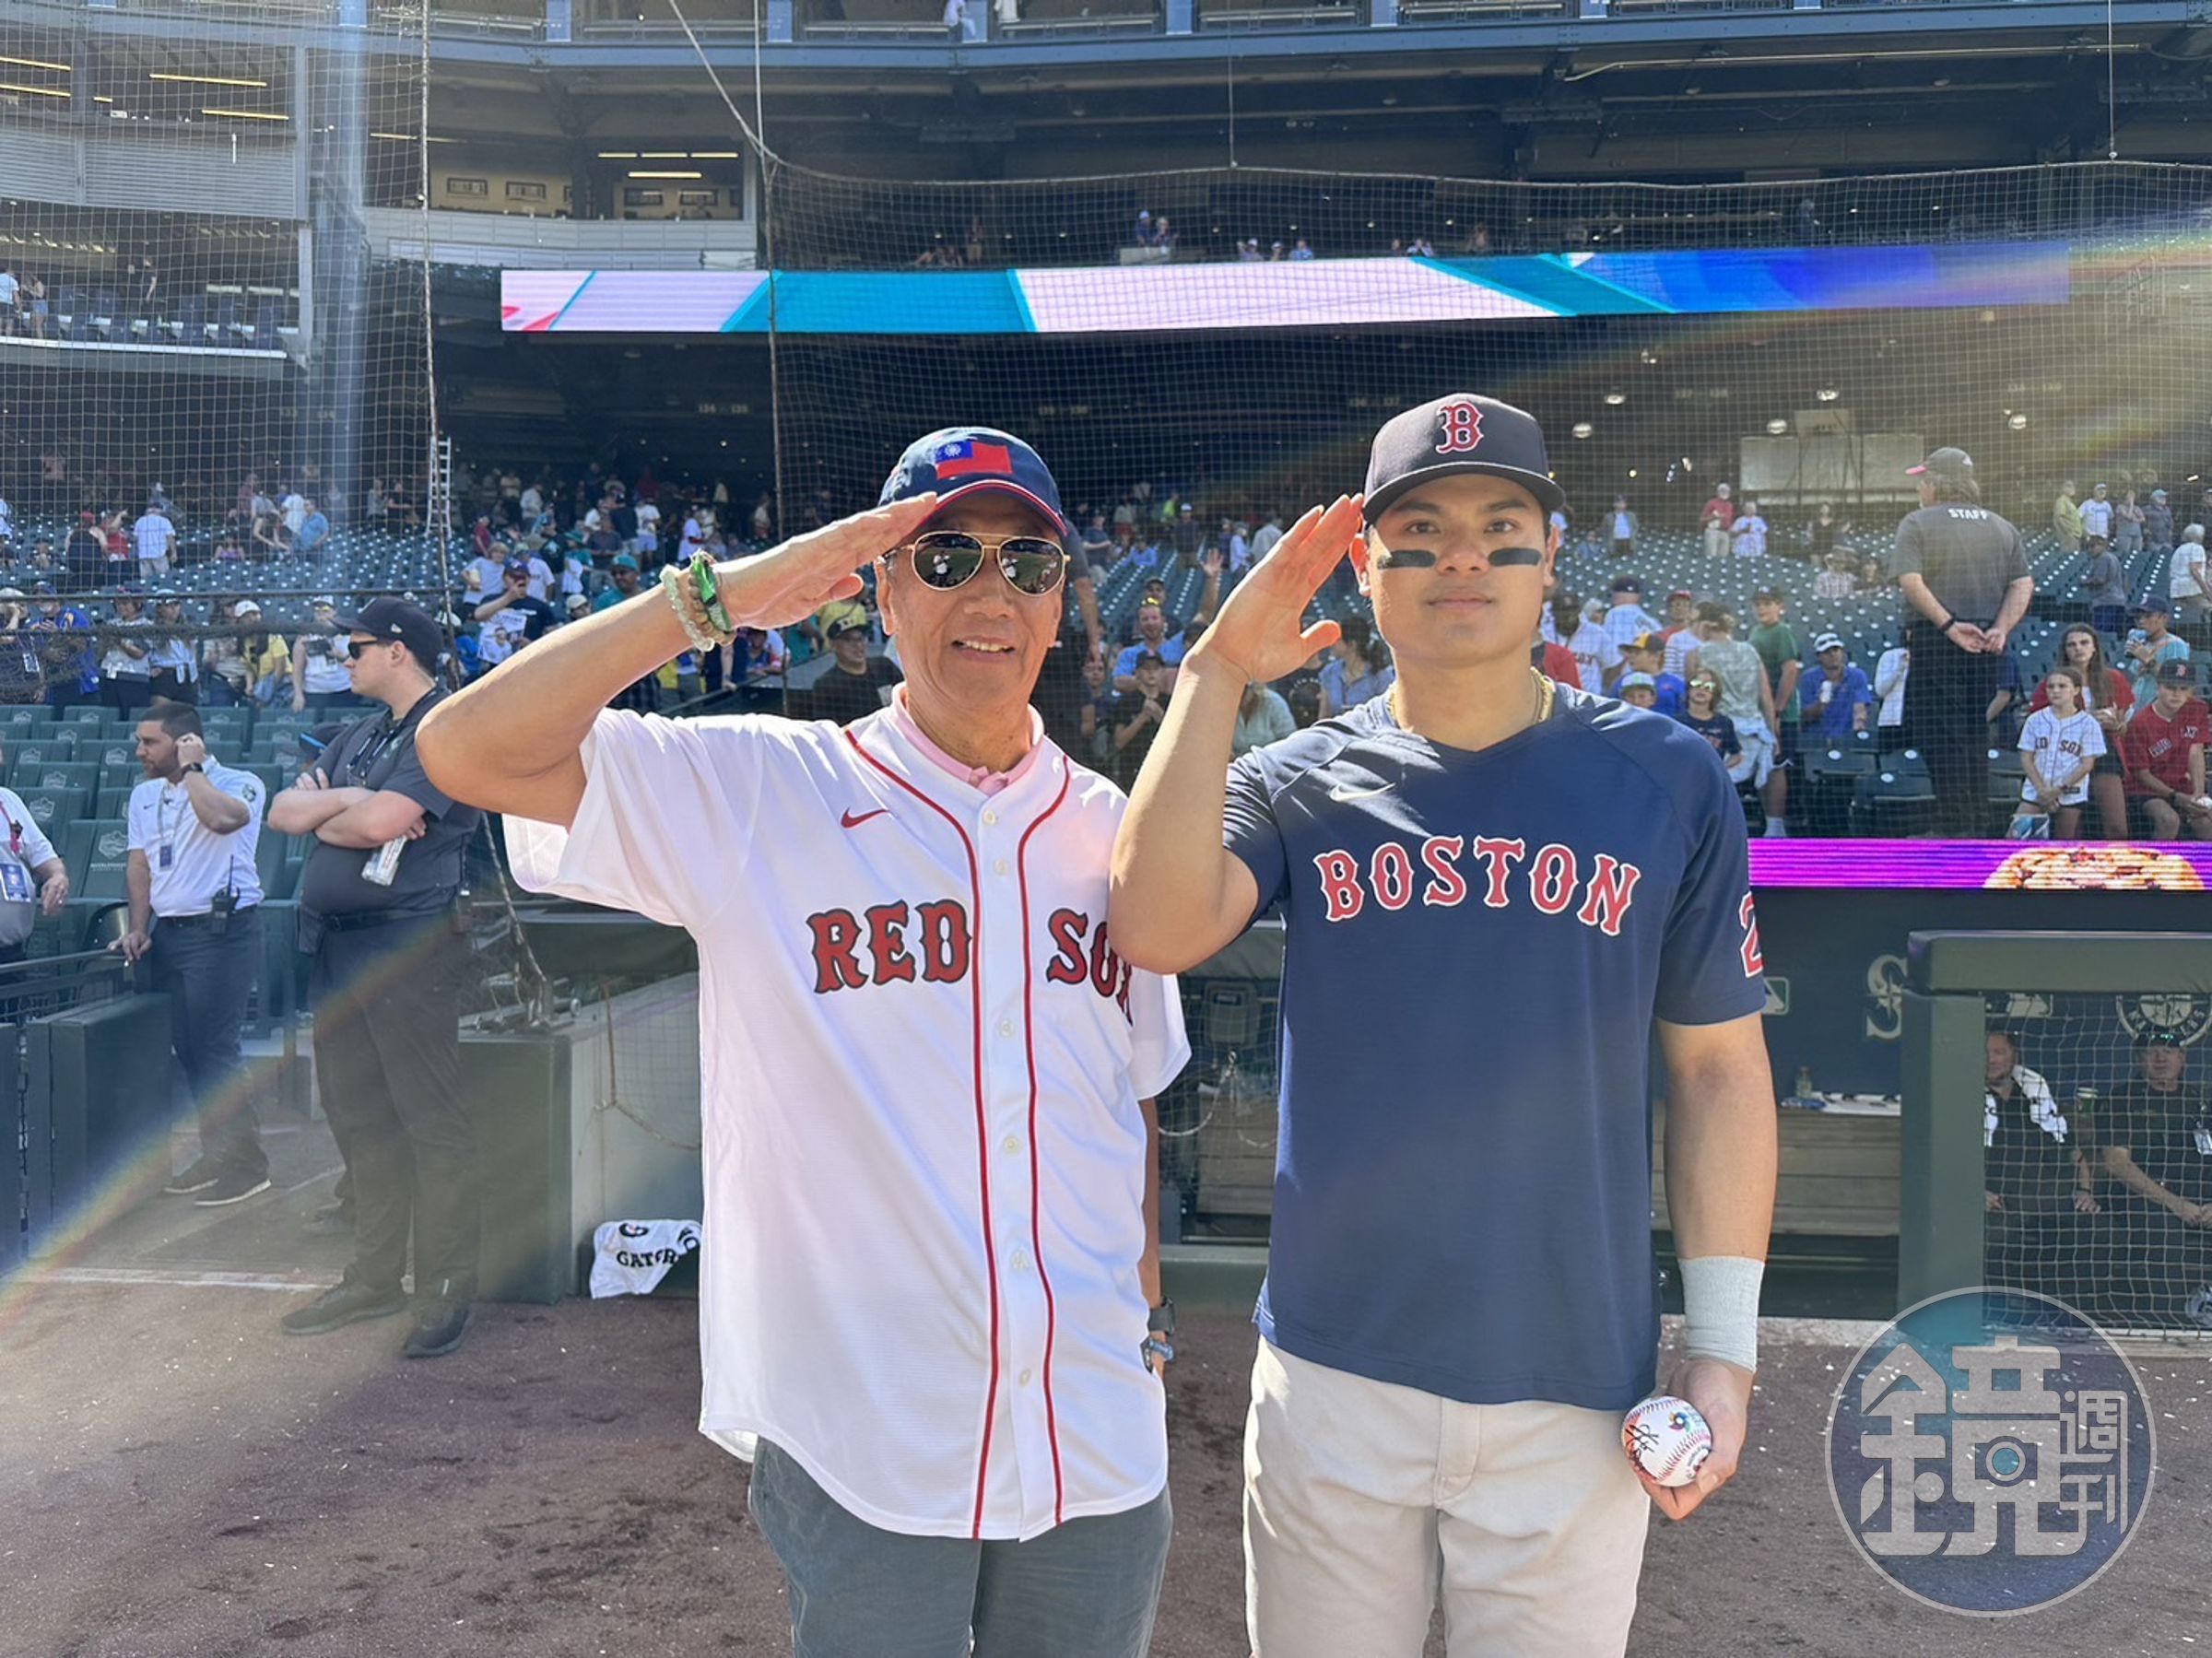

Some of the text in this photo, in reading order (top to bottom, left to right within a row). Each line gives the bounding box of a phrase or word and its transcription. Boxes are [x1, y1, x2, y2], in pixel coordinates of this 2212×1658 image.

[1435, 400, 1485, 454] B
[1947, 508, 1988, 521] STAFF
[1313, 835, 1641, 936] BOSTON
[806, 899, 972, 994] RED
